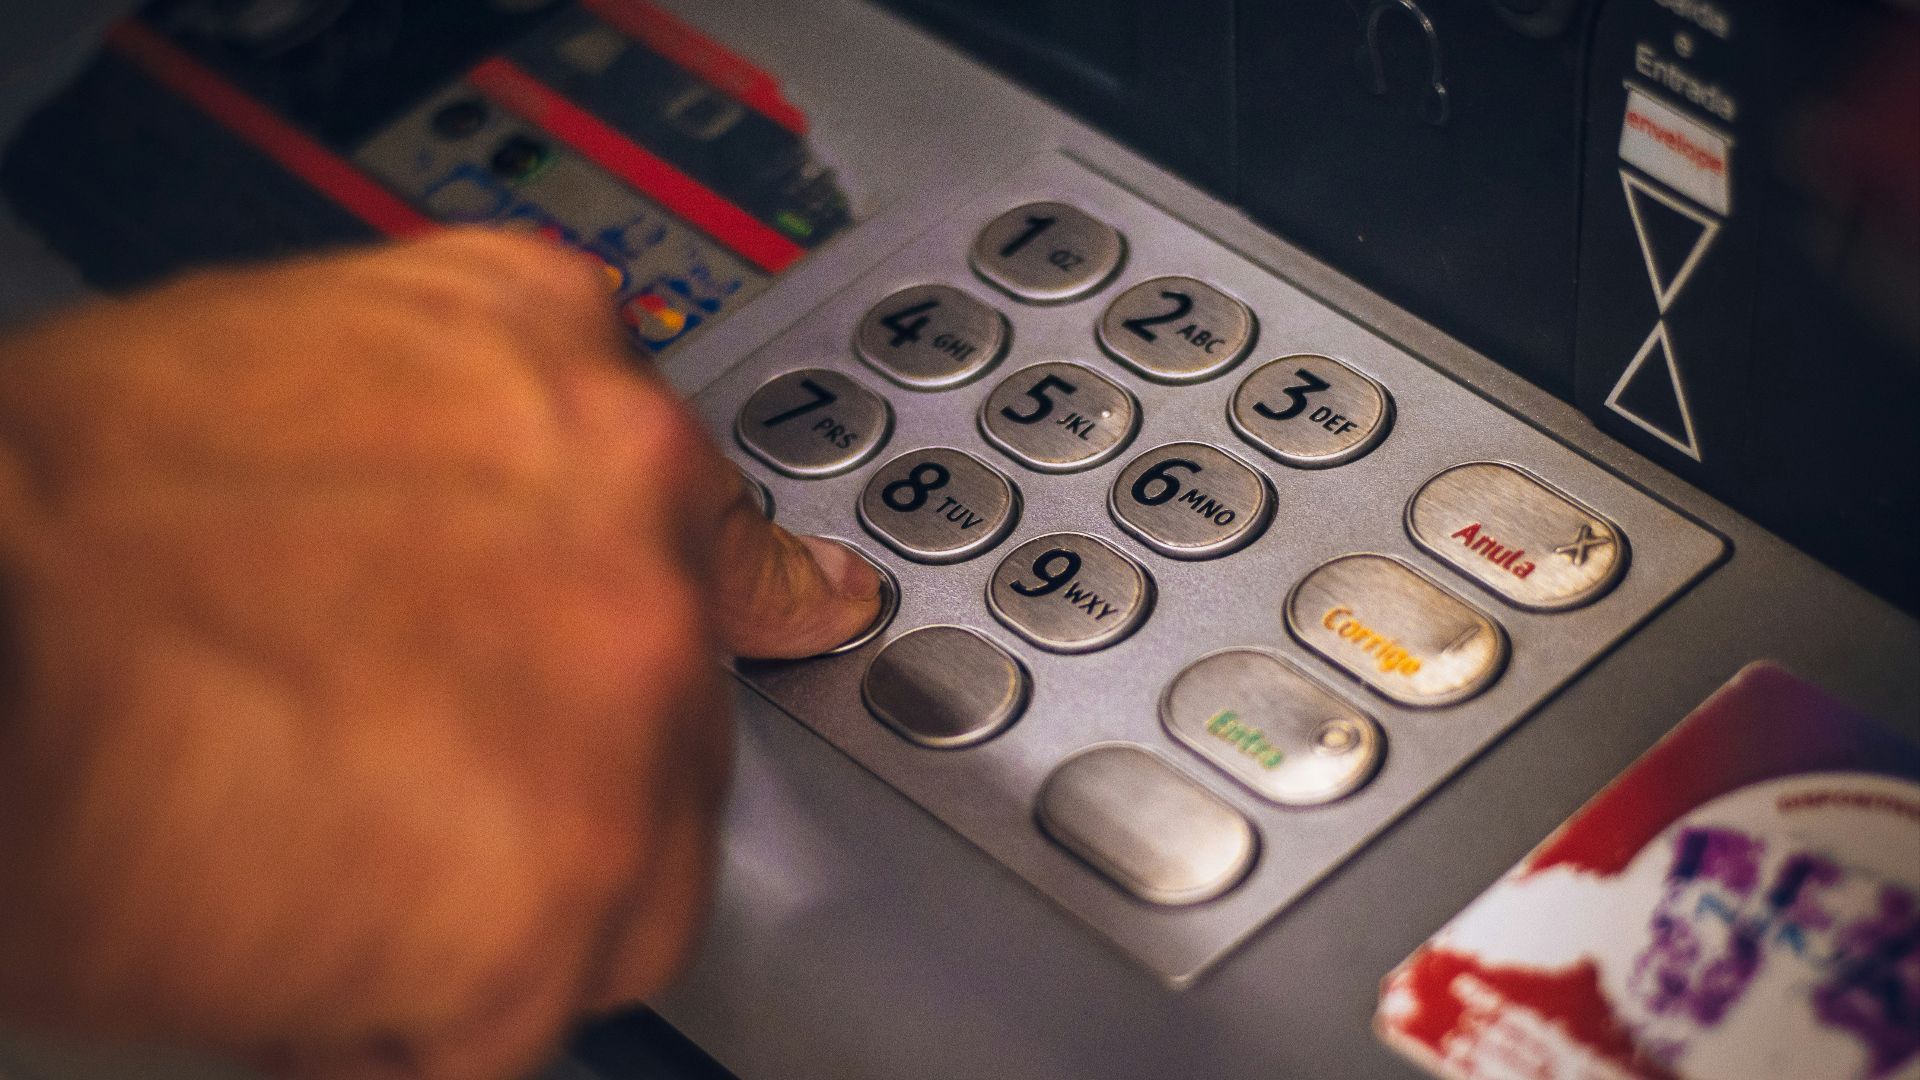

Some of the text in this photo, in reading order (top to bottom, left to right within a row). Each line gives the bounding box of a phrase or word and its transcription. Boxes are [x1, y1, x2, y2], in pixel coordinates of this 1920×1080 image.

[1674, 31, 1693, 58] e
[1635, 41, 1736, 121] Entrada
[1627, 111, 1724, 176] envelope
[1000, 215, 1056, 257] 1
[879, 298, 976, 362] 4 GHI
[1121, 291, 1225, 354] 2 ABC
[762, 378, 857, 449] 7 PRS
[1001, 374, 1096, 440] 5 JKL
[1253, 368, 1357, 435] 3 DEF
[882, 462, 984, 530] 8 TUV
[1131, 457, 1236, 526] 6 MNO
[1009, 547, 1118, 620] 9 WXY
[1451, 522, 1536, 580] Anula
[1323, 605, 1422, 676] Corrige
[1206, 709, 1284, 770] Entra
